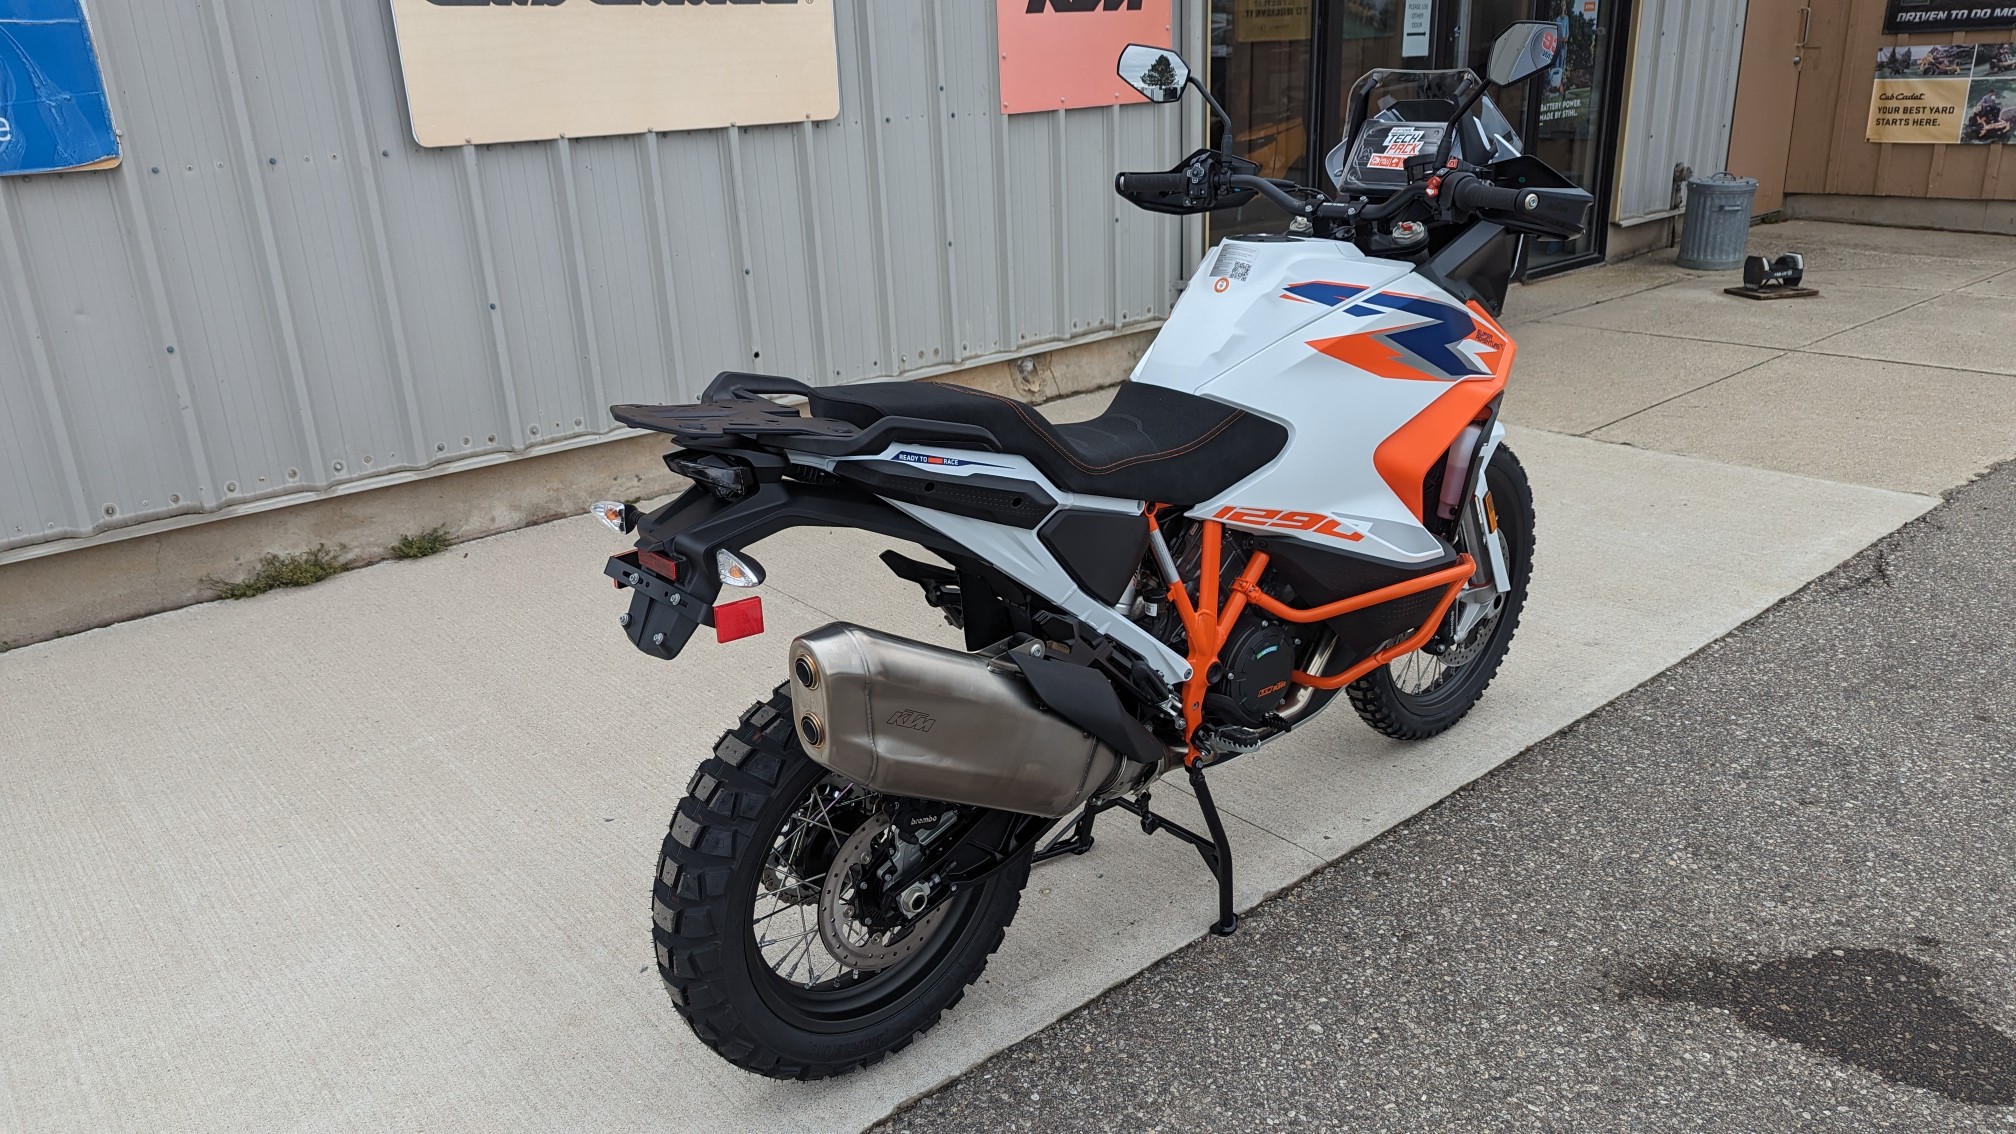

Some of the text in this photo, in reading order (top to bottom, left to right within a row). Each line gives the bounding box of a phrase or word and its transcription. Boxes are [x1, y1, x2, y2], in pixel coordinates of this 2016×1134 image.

[1896, 10, 1948, 22] DRIVEN
[1951, 9, 1969, 20] TO
[1970, 8, 1992, 19] DO
[1879, 92, 1926, 101] Cub Cadet
[1540, 99, 1582, 112] BATTERY POWER.
[1877, 106, 1956, 115] YOUR BEST YARD
[1539, 111, 1554, 121] MADE
[1554, 110, 1562, 119] BY
[1875, 118, 1941, 127] STARTS HERE.
[1387, 134, 1421, 144] TECH
[1386, 143, 1421, 154] PACK
[899, 453, 959, 466] READY TO RACE
[886, 708, 937, 733] KTM
[910, 814, 938, 826] brembo
